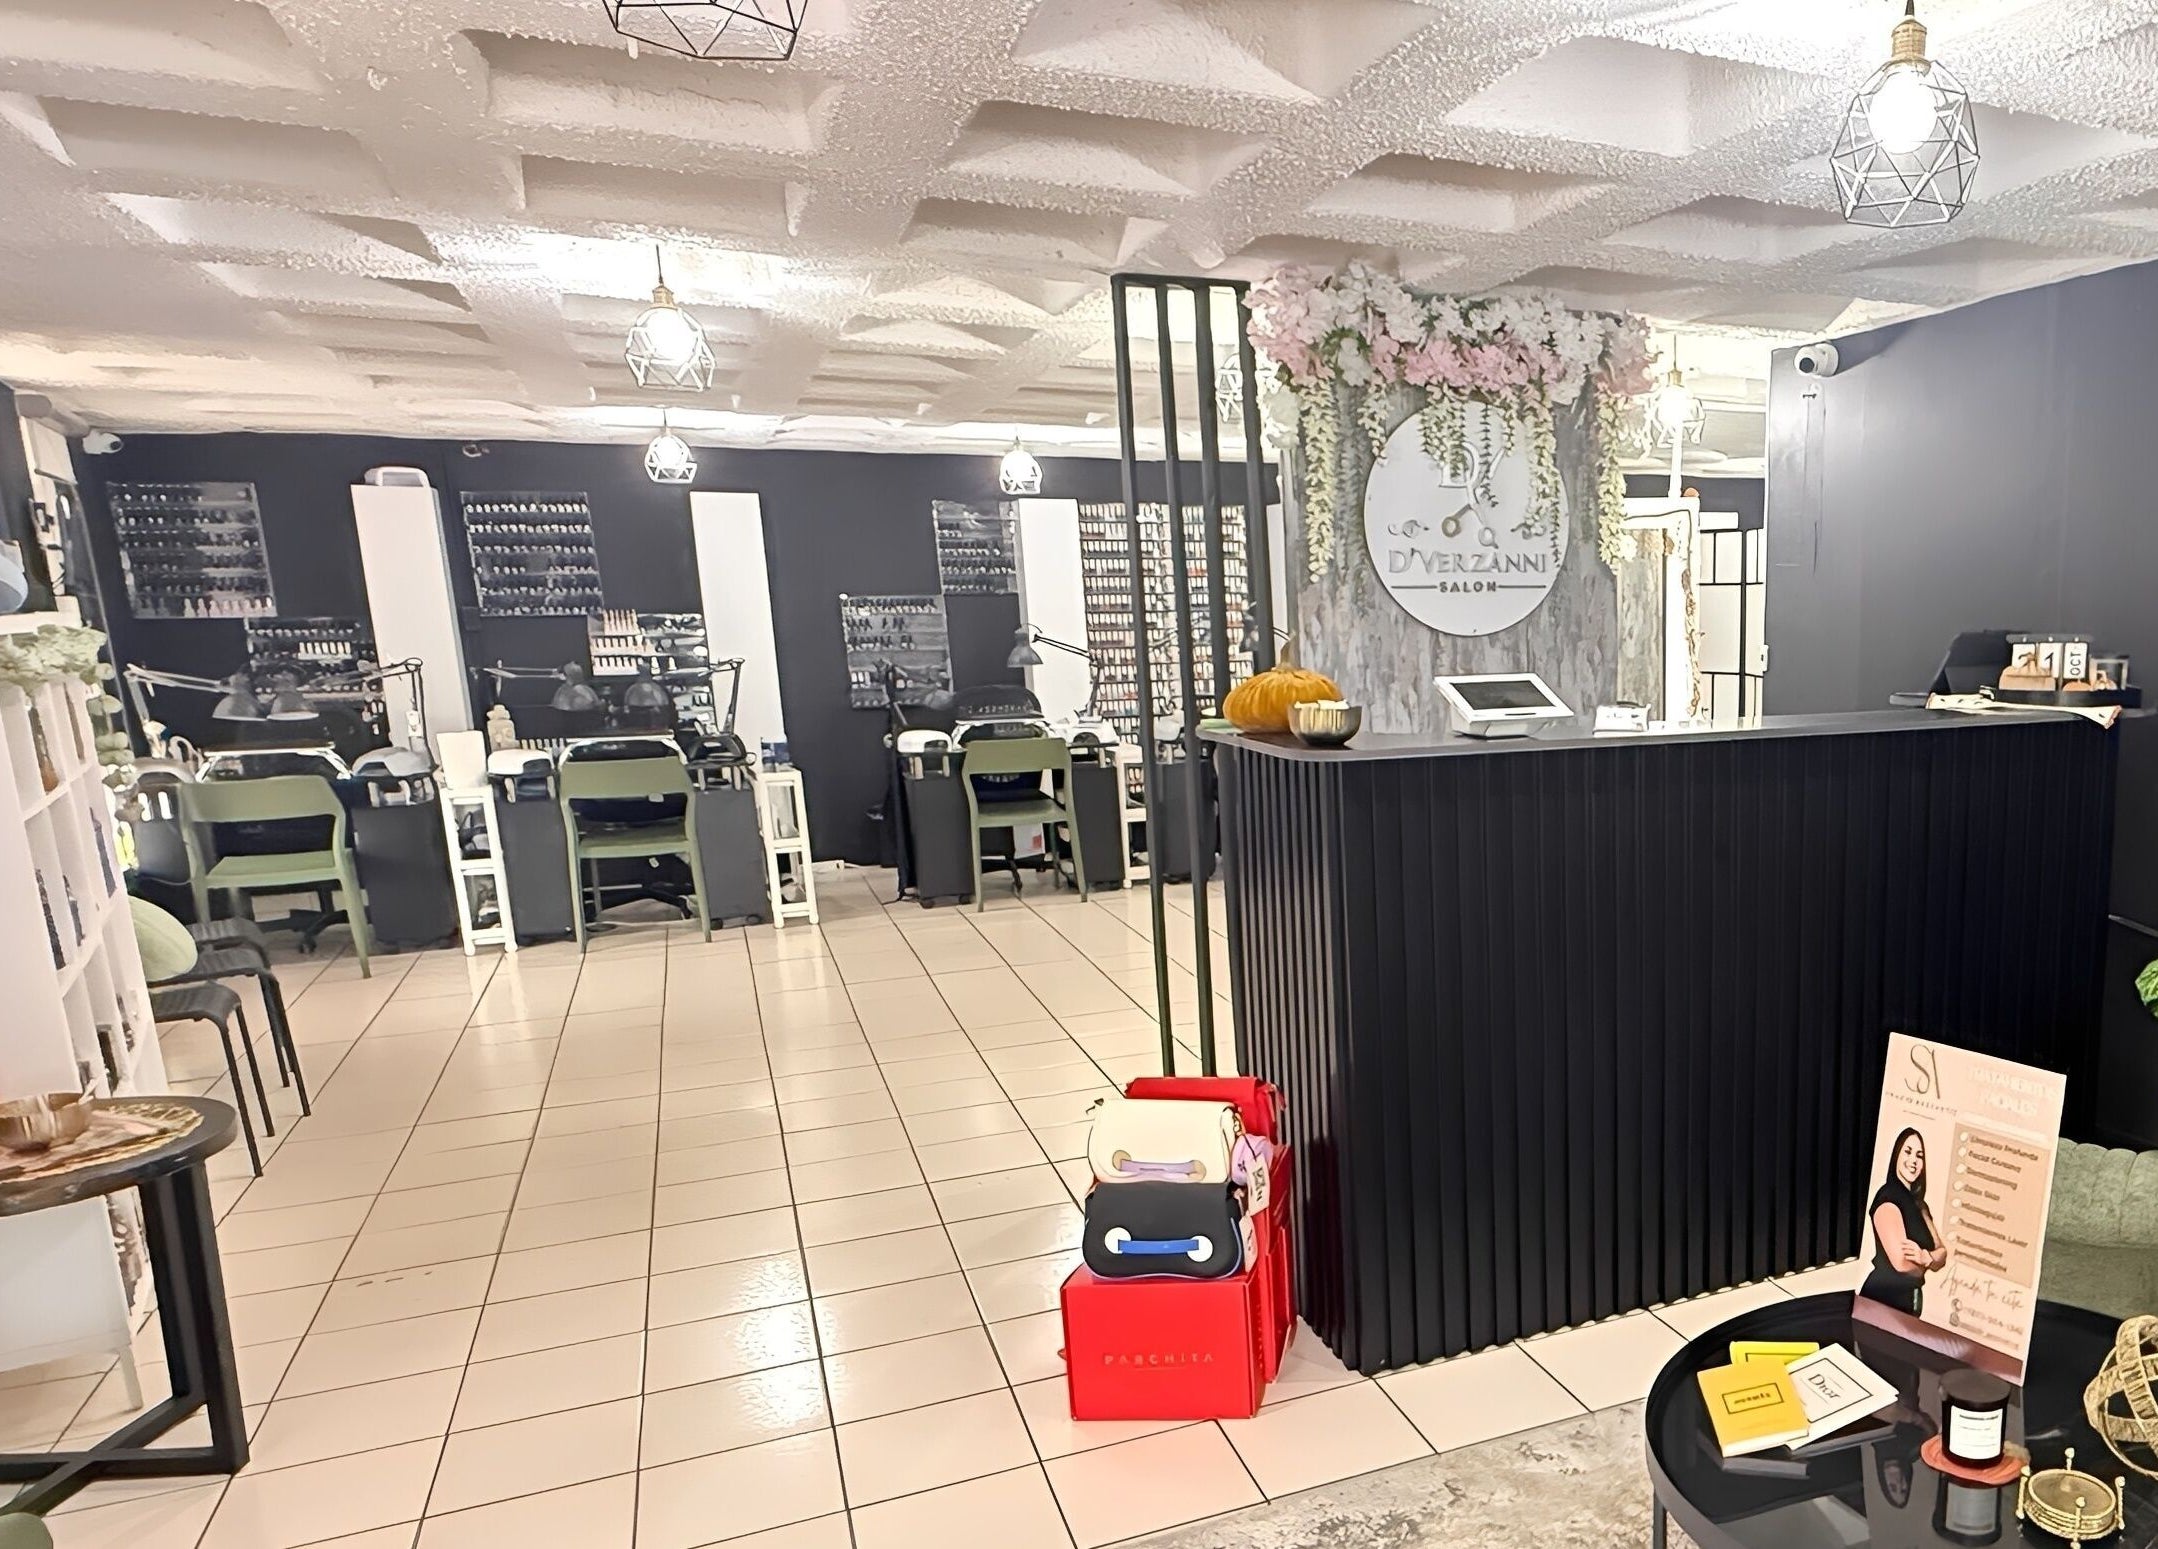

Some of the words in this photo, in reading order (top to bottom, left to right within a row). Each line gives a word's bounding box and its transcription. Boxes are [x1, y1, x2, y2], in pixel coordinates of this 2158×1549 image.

[1439, 581, 1497, 593] SALON
[2069, 651, 2082, 676] OCT
[1807, 1372, 1842, 1400] Dior
